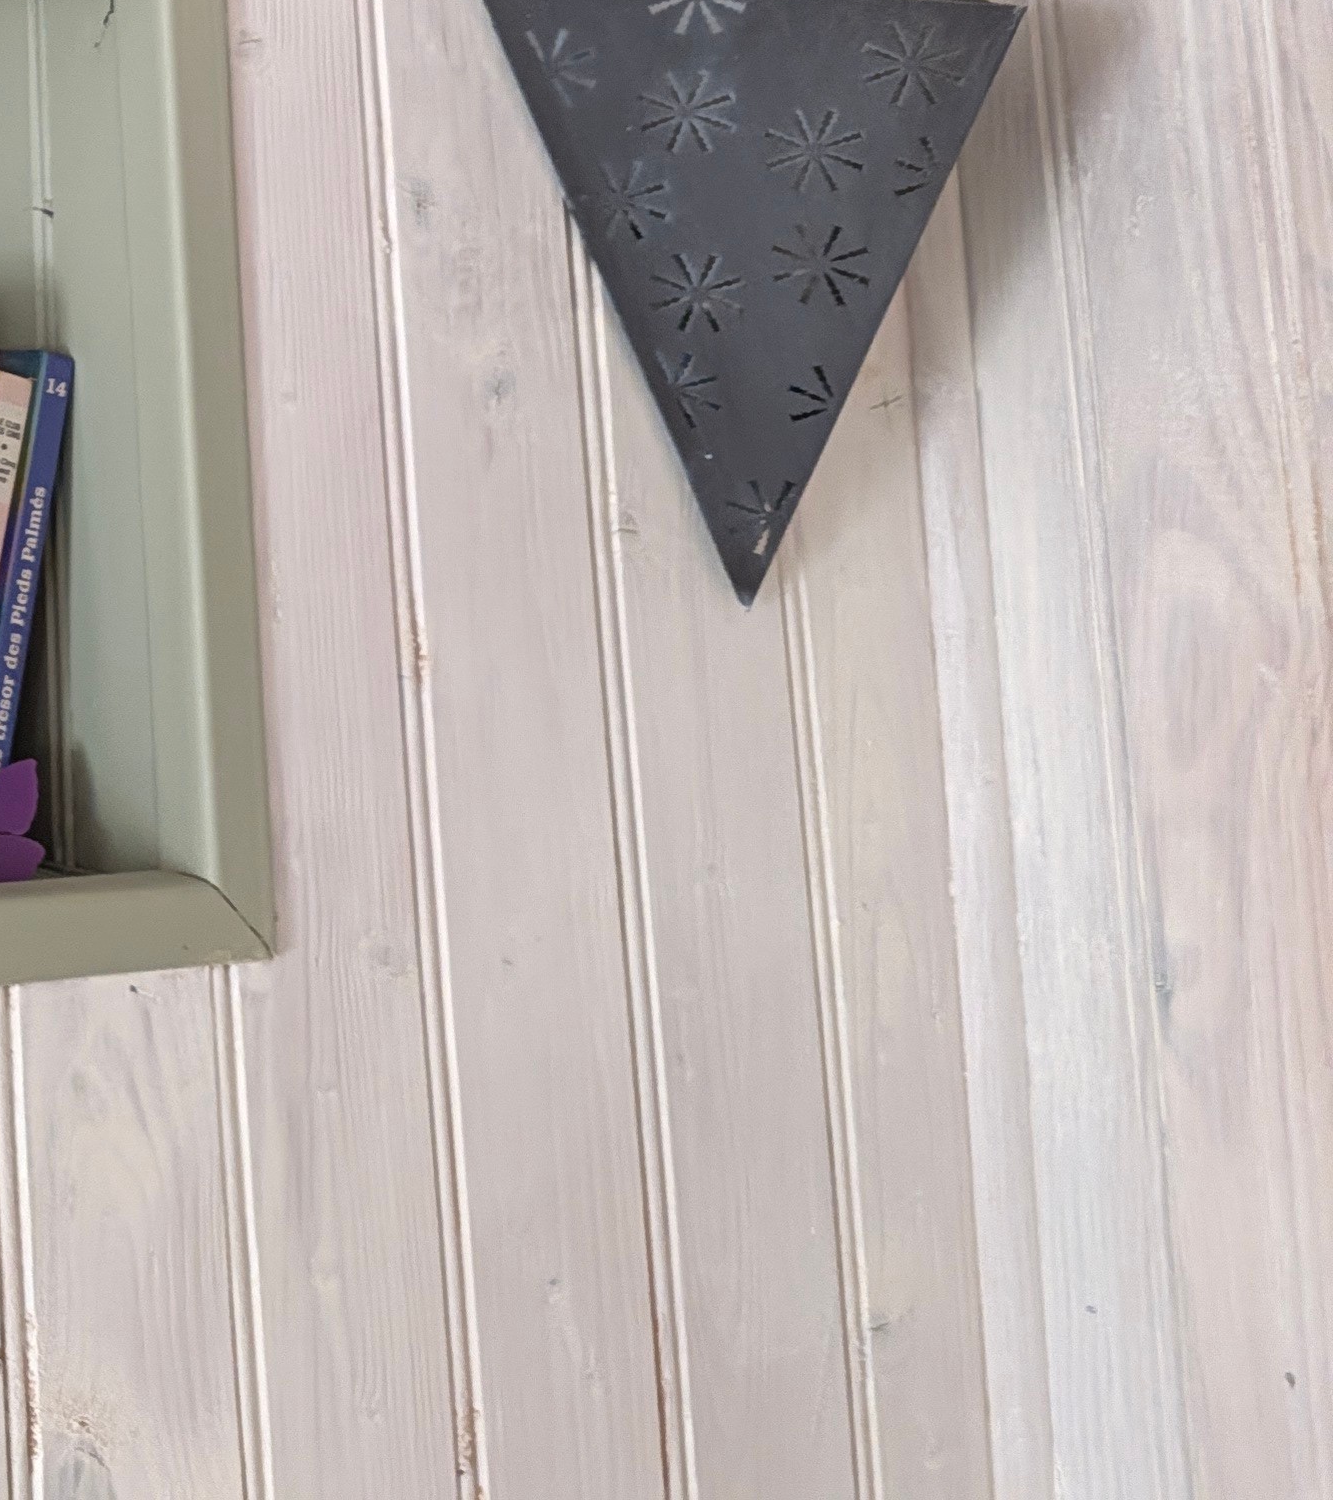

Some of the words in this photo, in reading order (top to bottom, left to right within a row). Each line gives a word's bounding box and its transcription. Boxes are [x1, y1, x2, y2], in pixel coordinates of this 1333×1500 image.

[45, 378, 68, 398] 14
[20, 486, 47, 563] Palmés
[10, 570, 33, 627] Pieds
[3, 633, 22, 670] des
